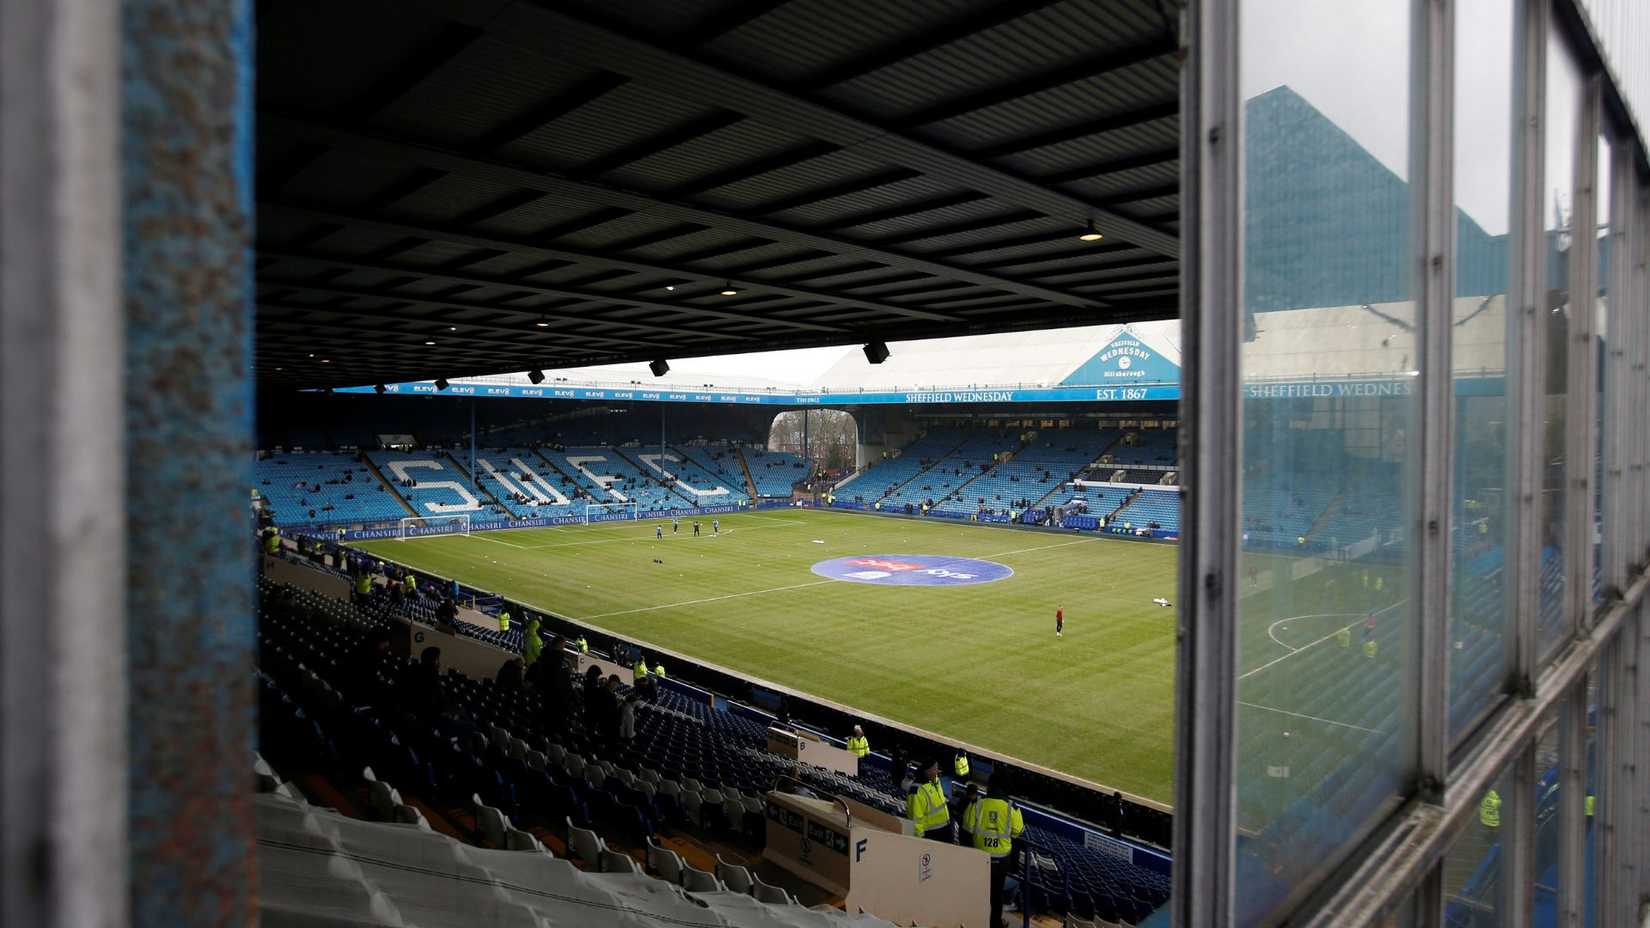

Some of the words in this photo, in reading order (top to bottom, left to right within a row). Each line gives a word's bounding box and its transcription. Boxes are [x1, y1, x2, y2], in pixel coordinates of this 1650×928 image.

[1100, 347, 1151, 363] WEDNESDAY
[1103, 370, 1145, 378] Hillsborough
[906, 392, 951, 402] SHEFFIELD
[953, 391, 1013, 402] WEDNESDAY
[1096, 389, 1118, 400] EST.
[1120, 388, 1148, 400] 1867
[1249, 384, 1333, 398] SHEFFIELD
[354, 530, 401, 538] CHANSIRI
[508, 518, 546, 527] CHANSIRI
[984, 837, 999, 848] 128
[856, 838, 868, 863] F
